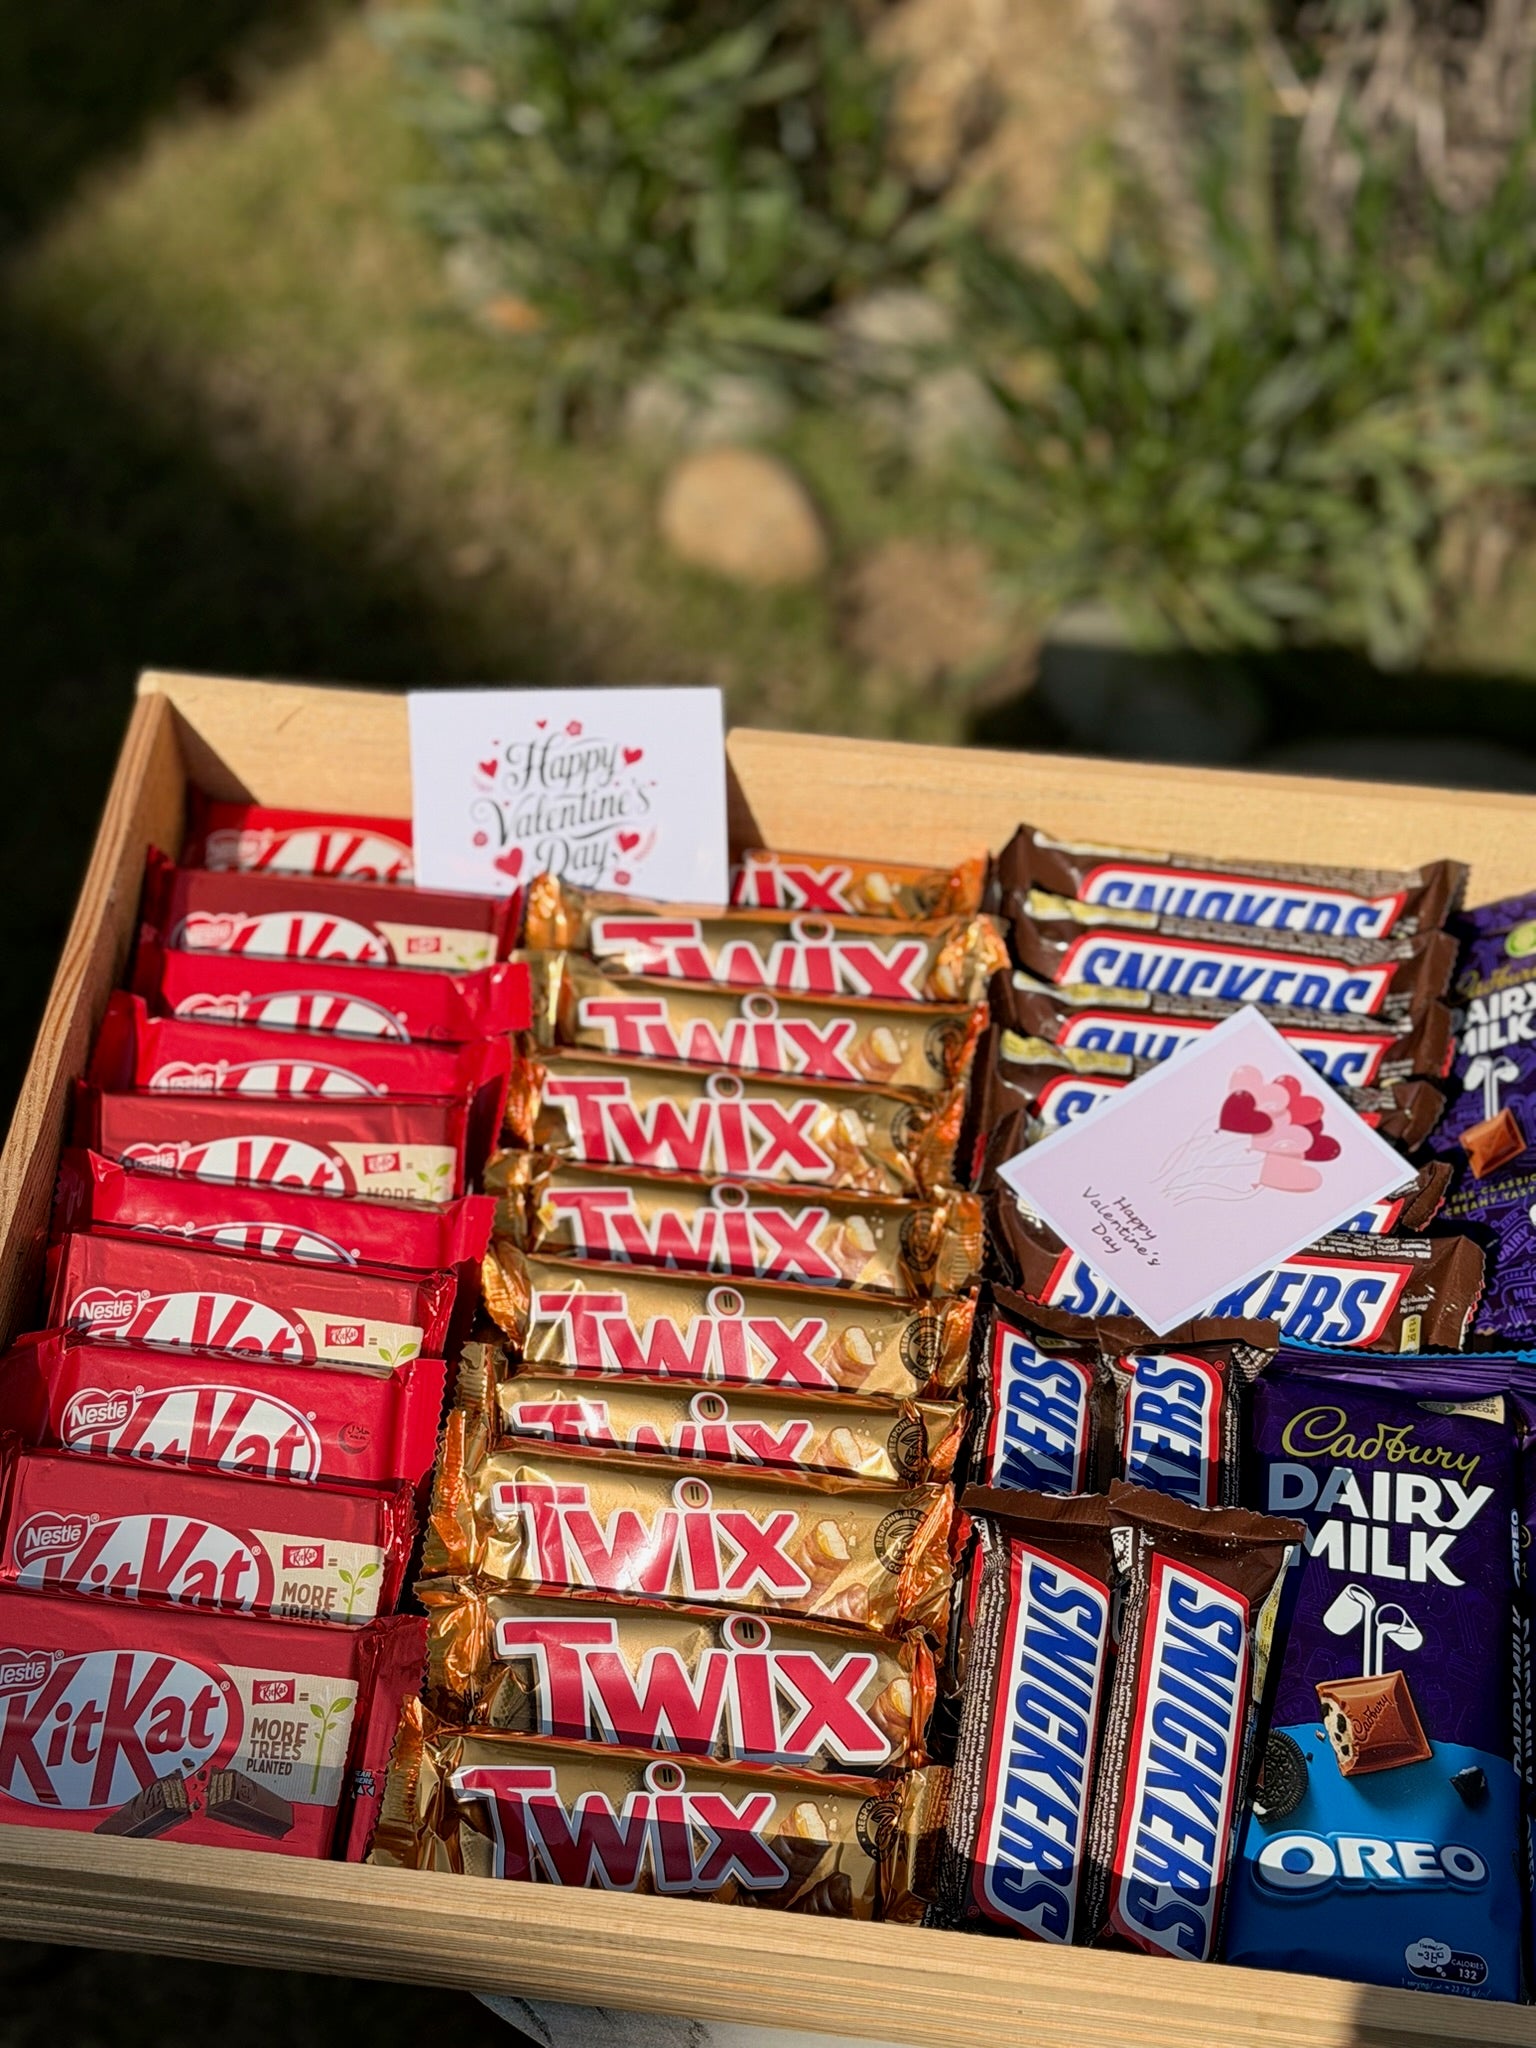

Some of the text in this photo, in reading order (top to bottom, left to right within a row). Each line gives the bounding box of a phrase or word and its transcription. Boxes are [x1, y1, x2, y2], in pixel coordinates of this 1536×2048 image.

[505, 732, 619, 790] Happy
[535, 837, 620, 886] Day
[578, 992, 863, 1081] Twix
[543, 1073, 835, 1179] Twix
[1113, 1196, 1157, 1241] Happy
[1503, 1184, 1536, 1203] TAST
[542, 1182, 842, 1287] Twix
[1083, 1186, 1160, 1266] Valentine's
[1092, 1221, 1122, 1254] Day
[80, 1299, 134, 1321] Nestlé
[532, 1285, 839, 1391] Twix
[70, 1400, 128, 1427] Nestlé
[1281, 1406, 1480, 1486] Cadbury
[1268, 1462, 1495, 1531] DAIRY
[25, 1524, 82, 1548] Nestlé
[492, 1477, 810, 1599] Twix
[1298, 1520, 1466, 1587] MILK
[281, 1581, 338, 1611] MORE
[496, 1614, 891, 1766] Twix
[1352, 1695, 1390, 1742] Cadbury
[0, 1653, 221, 1806] KitKat
[250, 1717, 309, 1745] MORE
[250, 1740, 302, 1761] TREES
[990, 1561, 1105, 1944] SNICKERS
[246, 1758, 293, 1776] PLANTED
[1119, 1575, 1244, 1961] SNICKERS
[453, 1760, 789, 1893] Twix
[1256, 1833, 1488, 1890] OREO
[1451, 1959, 1484, 1970] CALORIES
[1459, 1968, 1477, 1980] 132
